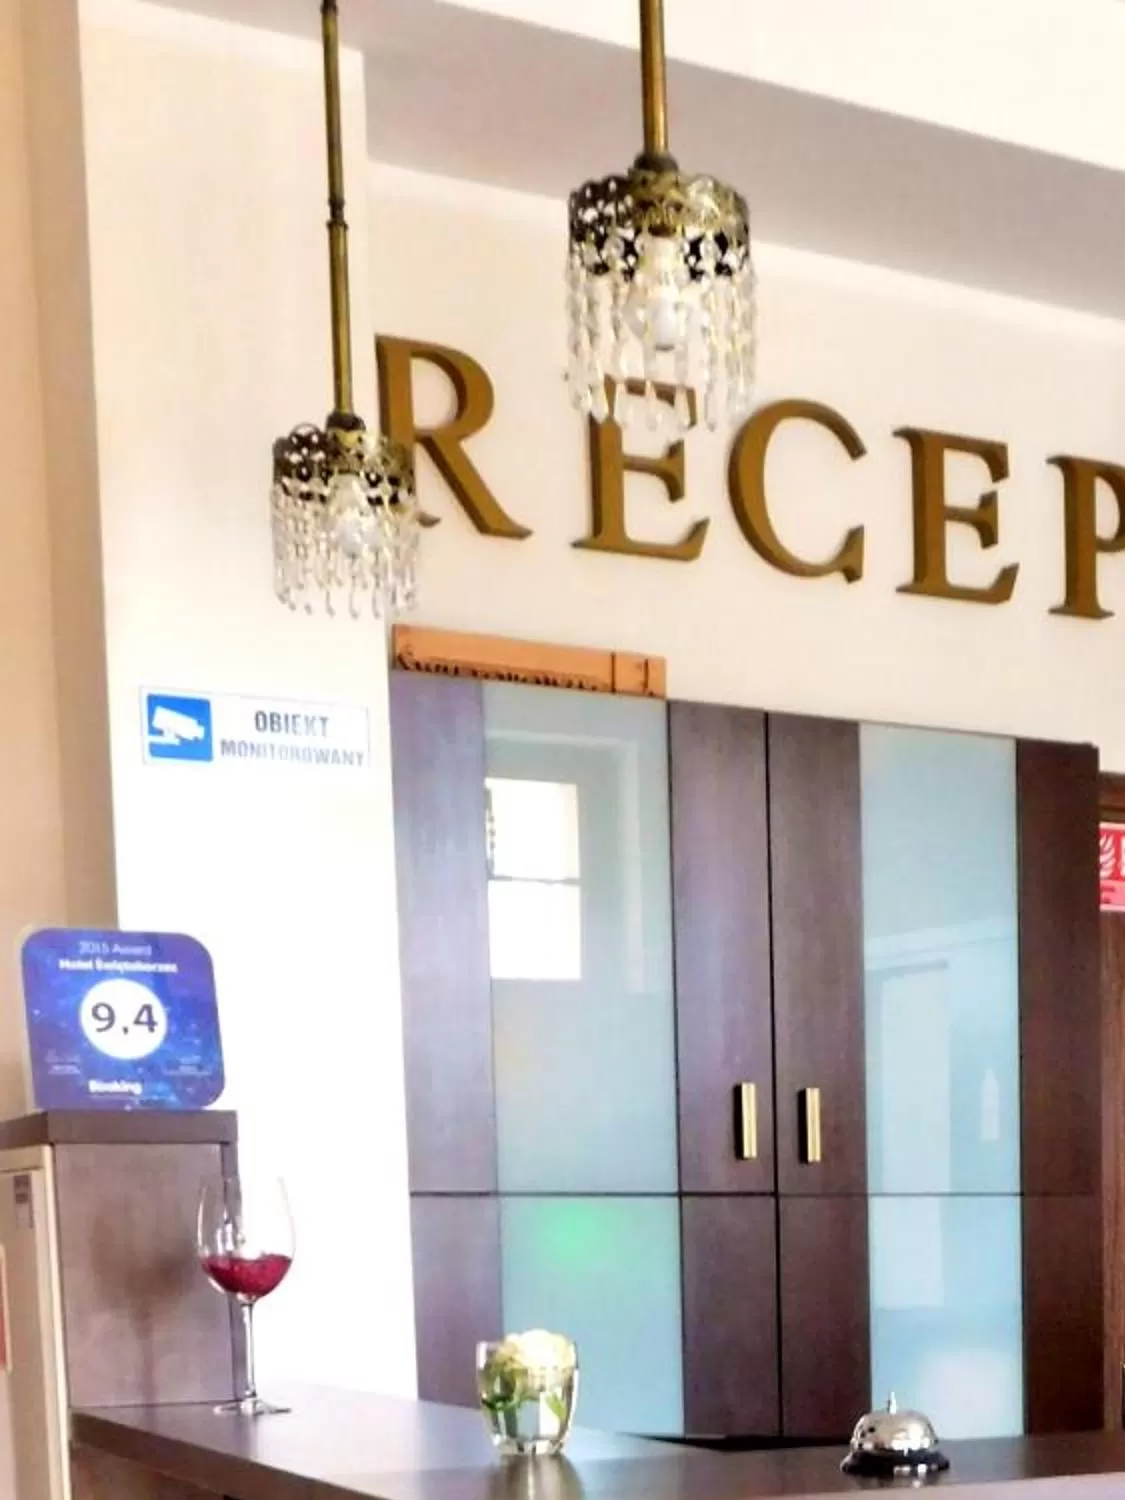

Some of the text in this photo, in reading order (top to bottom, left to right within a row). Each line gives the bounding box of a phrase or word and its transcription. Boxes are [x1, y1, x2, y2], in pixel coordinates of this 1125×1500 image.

[254, 710, 330, 738] OBIEKT
[220, 739, 365, 768] MONITOROWANY
[91, 1002, 158, 1035] 9,4
